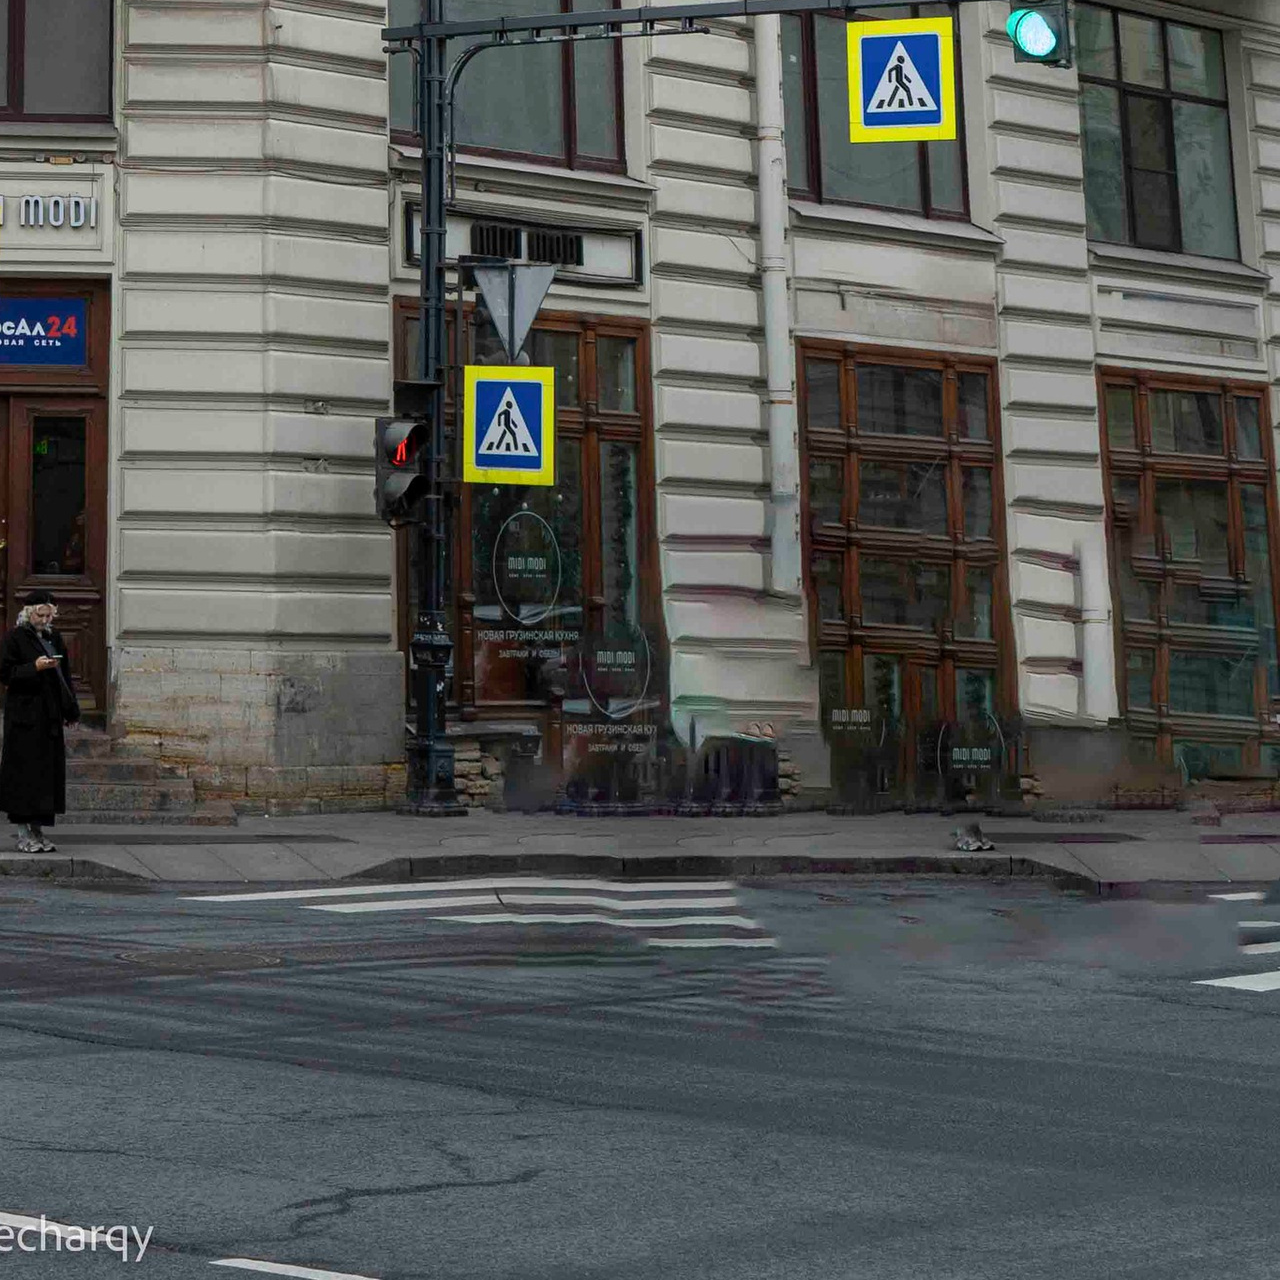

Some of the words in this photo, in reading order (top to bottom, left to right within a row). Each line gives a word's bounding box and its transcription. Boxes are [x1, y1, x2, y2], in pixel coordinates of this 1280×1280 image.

[20, 196, 97, 228] MODI
[34, 339, 62, 347] СЕТЬ
[508, 557, 525, 570] MIDI
[527, 557, 547, 570] MODI
[477, 630, 505, 641] НОВАЯ
[505, 630, 554, 641] ГРУЗИНСКАЯ
[555, 630, 579, 641] КУХНЯ
[498, 649, 529, 658] ЗАВТРАКИ
[596, 650, 614, 664] MIDI
[616, 650, 635, 664] MODI
[832, 709, 849, 723] MIDI
[851, 709, 871, 723] MODI
[566, 724, 593, 735] НОВАЯ
[594, 724, 643, 736] ГРУЗИНСКАЯ
[952, 747, 970, 761] MIDI
[972, 747, 991, 761] MODI
